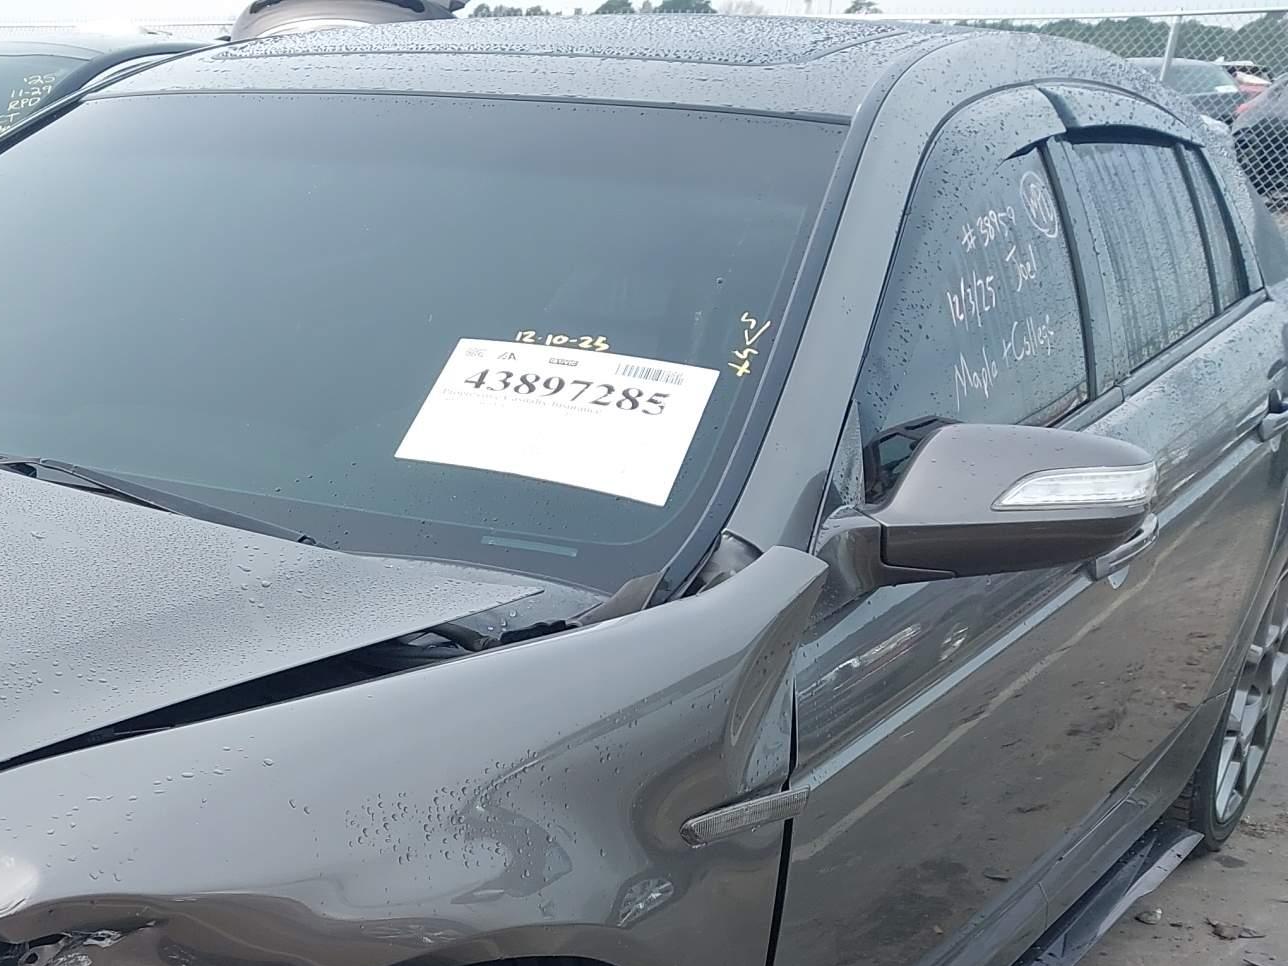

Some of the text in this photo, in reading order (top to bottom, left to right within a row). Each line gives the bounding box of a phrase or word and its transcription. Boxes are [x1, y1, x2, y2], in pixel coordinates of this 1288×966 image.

[7, 97, 41, 111] RPD
[10, 85, 53, 98] 11-29
[1005, 244, 1038, 292] Joel
[946, 270, 996, 332] 12/3/25
[463, 368, 671, 416] 43897285
